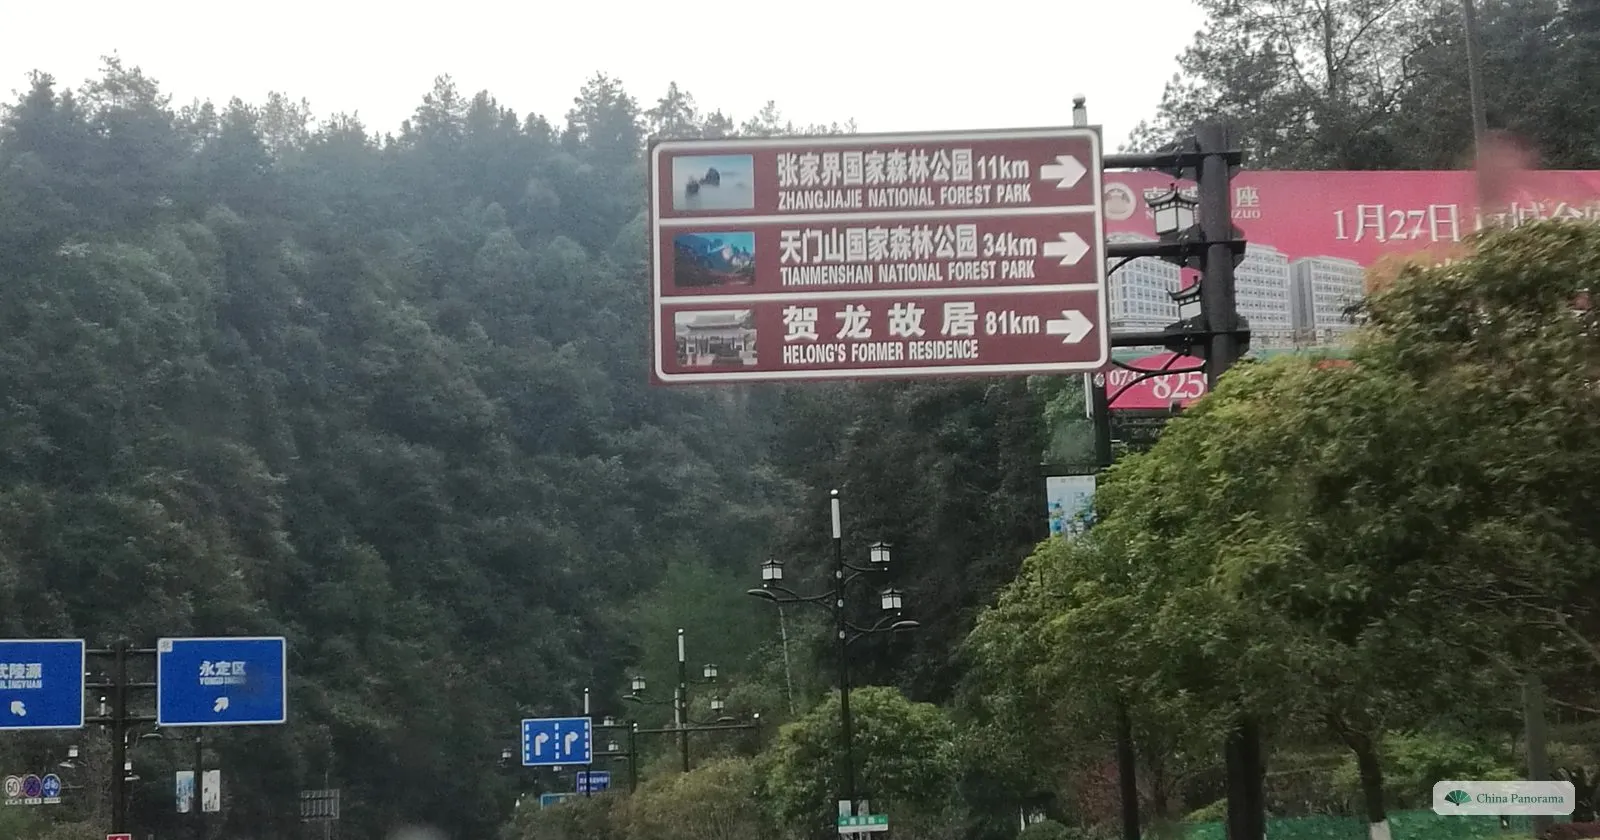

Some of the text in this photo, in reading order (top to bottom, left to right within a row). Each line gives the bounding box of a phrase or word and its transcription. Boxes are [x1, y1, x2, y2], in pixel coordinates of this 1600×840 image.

[777, 149, 1029, 187] 张家界国家森林公园 11km
[778, 184, 1031, 211] ZHANGJIAJIE NATIONAL FOREST PARK
[1333, 204, 1461, 243] 1月27日
[779, 224, 1037, 263] 天门山国家森林公园 34km
[780, 260, 1035, 285] TIANMENSHAN NATIONAL FOREST PARK
[783, 301, 1040, 341] 贺龙故居 81km
[783, 339, 979, 364] HELONG'S FORMER RESIDENCE
[1153, 371, 1209, 399] 825
[200, 660, 246, 676] 永定区
